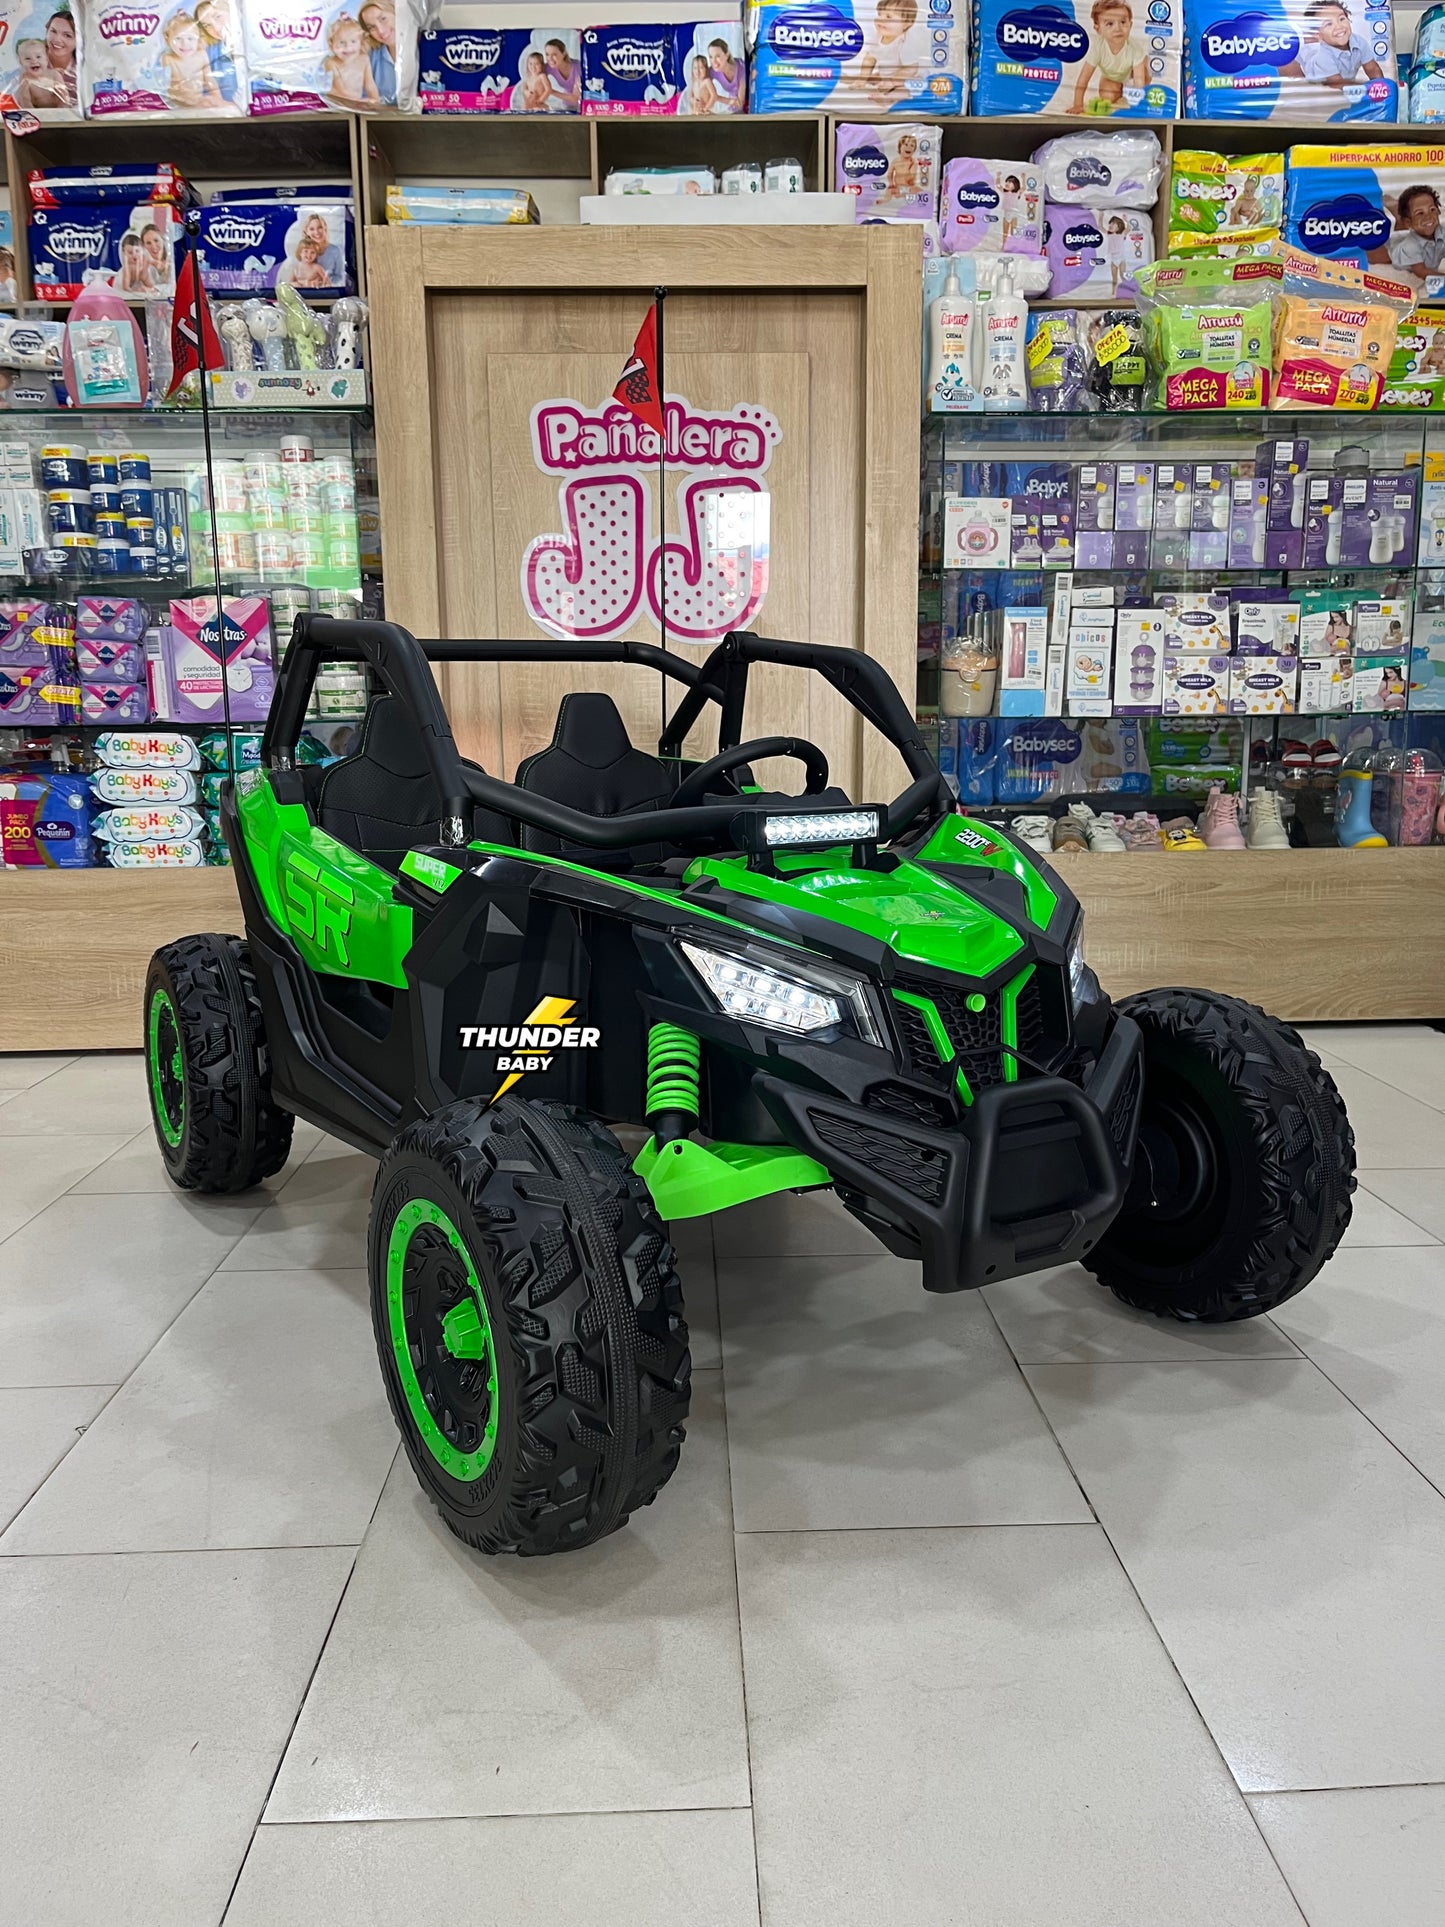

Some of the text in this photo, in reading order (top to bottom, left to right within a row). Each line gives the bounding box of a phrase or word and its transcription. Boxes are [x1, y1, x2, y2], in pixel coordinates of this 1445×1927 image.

[102, 13, 158, 36] winny
[775, 26, 855, 48] Babysec
[1004, 24, 1081, 48] Babysec
[449, 43, 499, 64] winny
[1208, 35, 1291, 56] Babysec
[611, 47, 662, 72] winny
[998, 63, 1059, 80] ULTRA PROTECT
[1205, 78, 1233, 88] ULTRA
[612, 104, 624, 112] 50
[845, 157, 885, 170] Babysec
[1330, 150, 1444, 163] HIPERPACK AHORRO 100
[961, 191, 996, 203] Babysec
[1177, 179, 1236, 200] Bebex
[213, 221, 263, 245] winny
[1305, 218, 1385, 239] Babysec
[52, 230, 102, 255] winny
[1065, 233, 1100, 244] Babysec
[1238, 263, 1284, 273] MEGA PACK
[1286, 256, 1317, 273] Arrurrú
[1366, 276, 1410, 293] MEGA PACK
[1199, 314, 1243, 330] Arrurrú
[1323, 306, 1367, 327] Arrurrú
[1329, 329, 1356, 338] TOALLITAS
[13, 338, 42, 351] winny
[1180, 378, 1218, 392] MEGA
[1293, 370, 1332, 385] MEGA
[14, 389, 46, 401] winny
[1228, 391, 1244, 400] 240
[1295, 382, 1329, 395] PACK
[1339, 389, 1355, 399] 270
[1184, 390, 1218, 404] PACK
[544, 408, 760, 462] Pañalera
[1244, 608, 1260, 616] Only
[200, 625, 246, 643] Nostras
[1076, 631, 1105, 642] chicos
[180, 681, 193, 690] 40
[113, 739, 184, 756] Baby Kay's
[1013, 736, 1075, 754] Babysec
[107, 773, 178, 789] Baby Kay's
[1166, 774, 1226, 792] Bebex
[113, 813, 183, 829] Baby Kay's
[4, 827, 31, 838] 200
[36, 827, 70, 838] Pequeñín
[122, 843, 192, 858] Baby Kay's
[415, 854, 447, 878] SUPER
